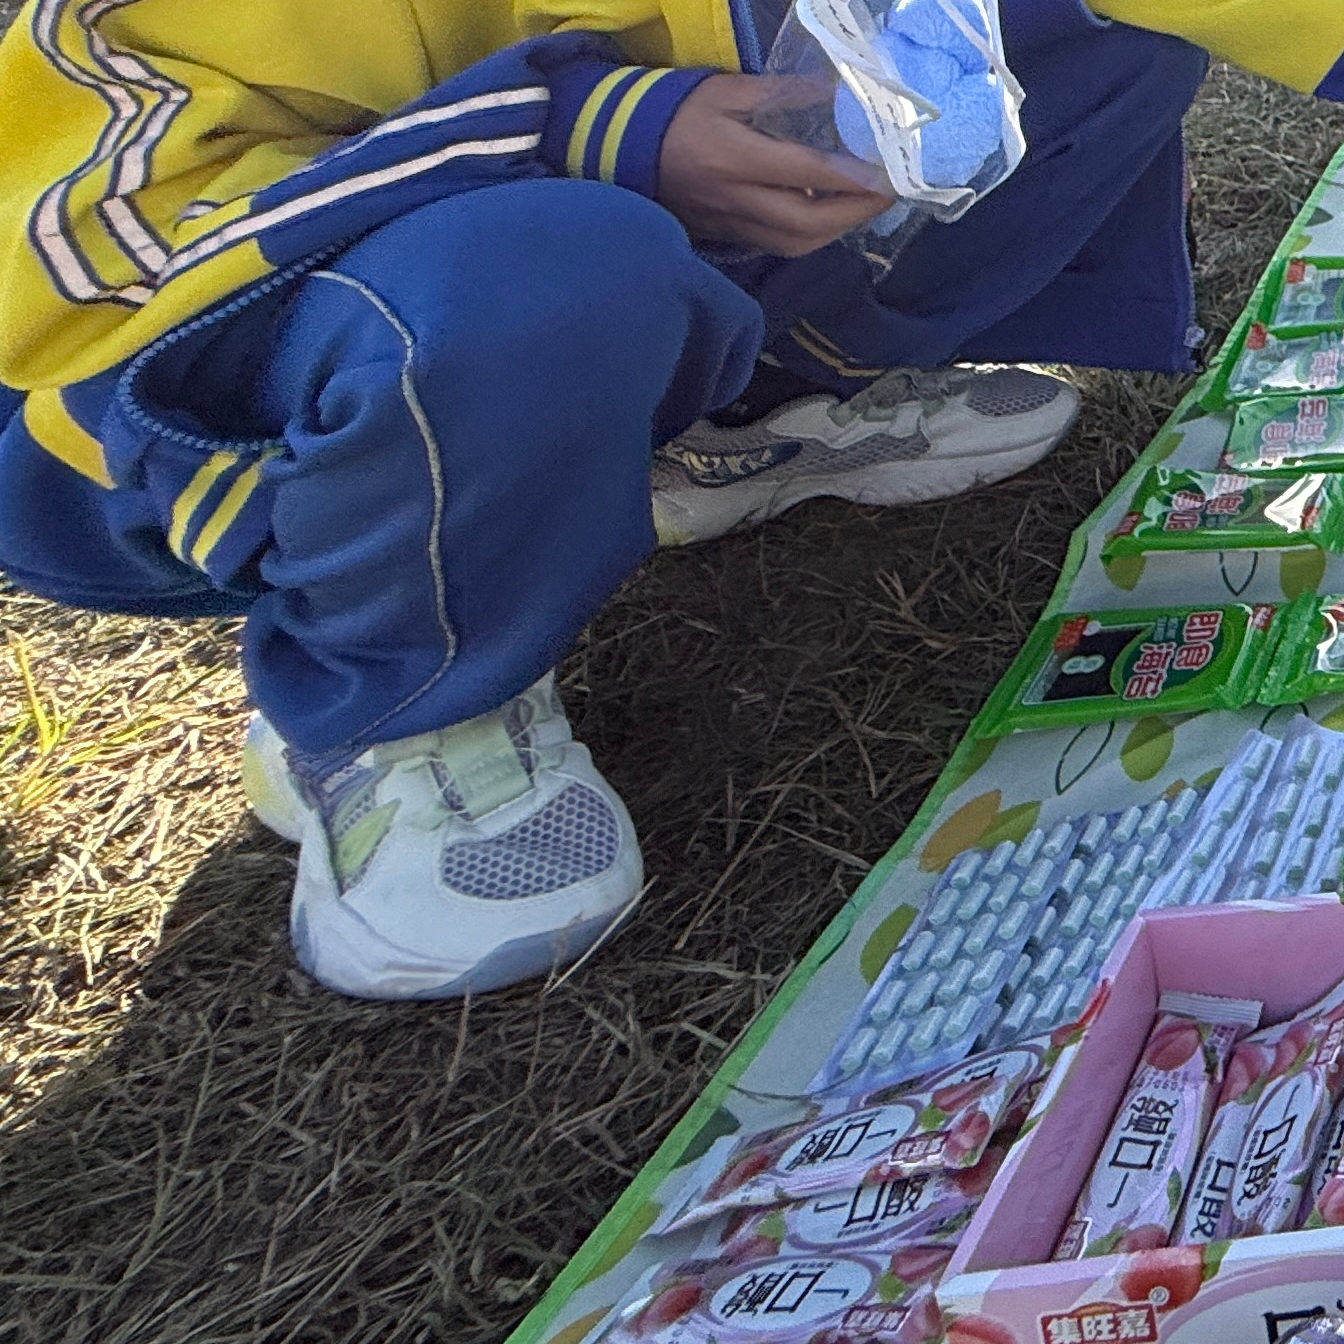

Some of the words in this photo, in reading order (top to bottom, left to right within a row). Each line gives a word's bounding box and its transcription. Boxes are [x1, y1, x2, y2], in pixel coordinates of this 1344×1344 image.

[1172, 610, 1224, 671] 即食
[1122, 641, 1178, 701] 海苔
[1106, 1095, 1180, 1209] 一口酸
[719, 1269, 850, 1318] 一口酸
